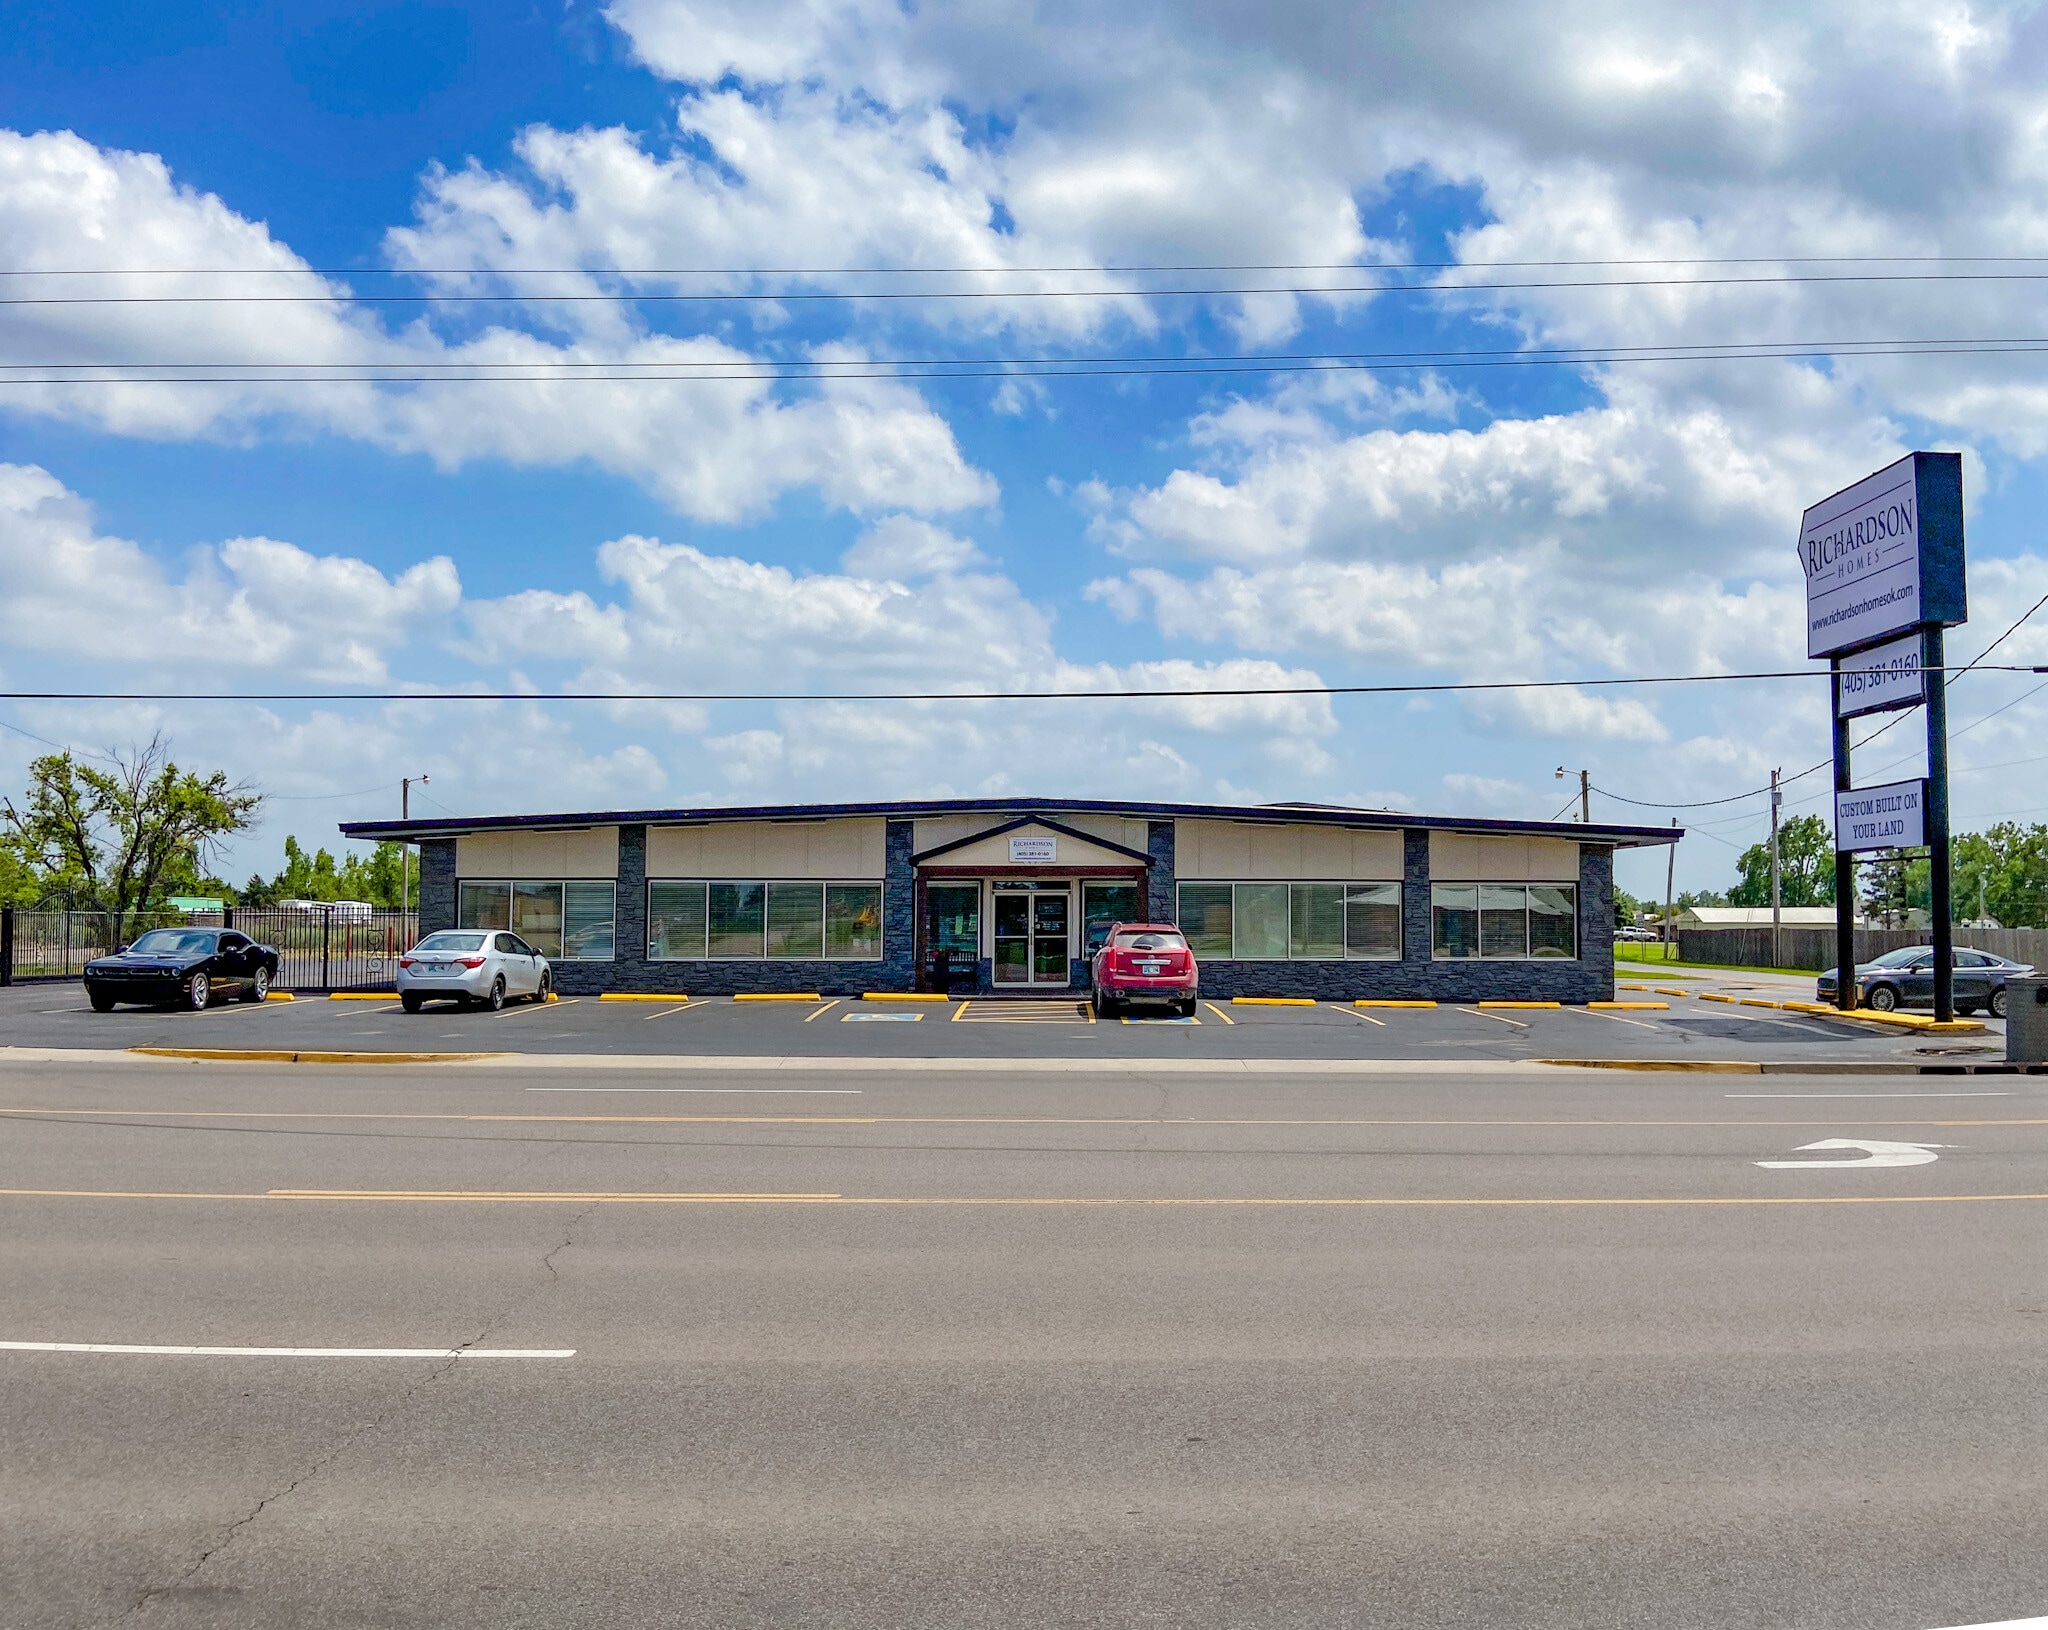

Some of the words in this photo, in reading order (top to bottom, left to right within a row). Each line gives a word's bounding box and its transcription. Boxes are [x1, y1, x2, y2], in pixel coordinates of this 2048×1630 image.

[1808, 499, 1912, 577] RICHARDSON
[1838, 548, 1880, 578] HOMES
[1812, 585, 1913, 631] www.richardsonhomesok.com
[1841, 667, 1866, 698] (405)
[1868, 653, 1919, 688] 381-0160
[1840, 800, 1873, 817] CUSTOM
[1876, 795, 1902, 813] BUILT
[1904, 793, 1918, 810] ON
[1853, 823, 1876, 839] YOUR
[1878, 819, 1904, 837] LAND
